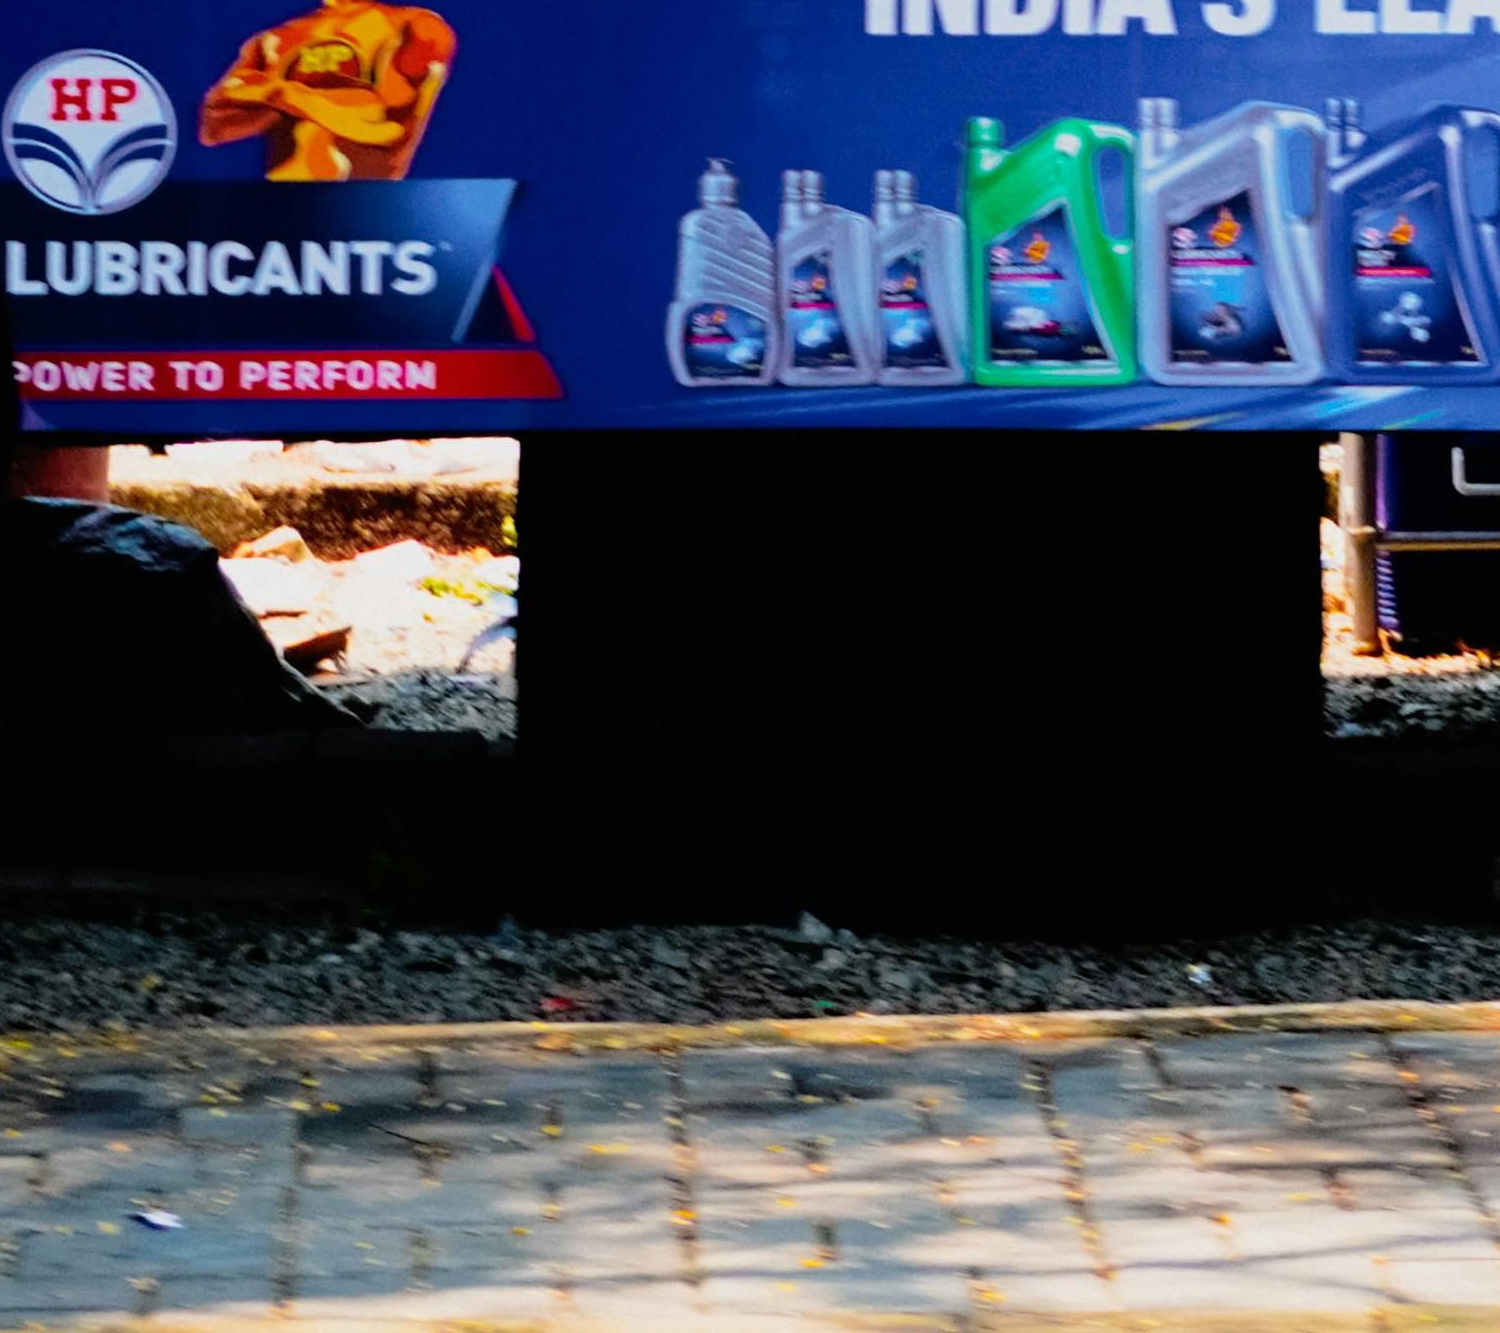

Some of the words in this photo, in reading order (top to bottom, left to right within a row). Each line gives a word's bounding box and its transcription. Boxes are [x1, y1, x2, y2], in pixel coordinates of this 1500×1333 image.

[49, 78, 138, 122] HP
[4, 240, 439, 296] LUBRICANTS
[168, 361, 224, 391] TO
